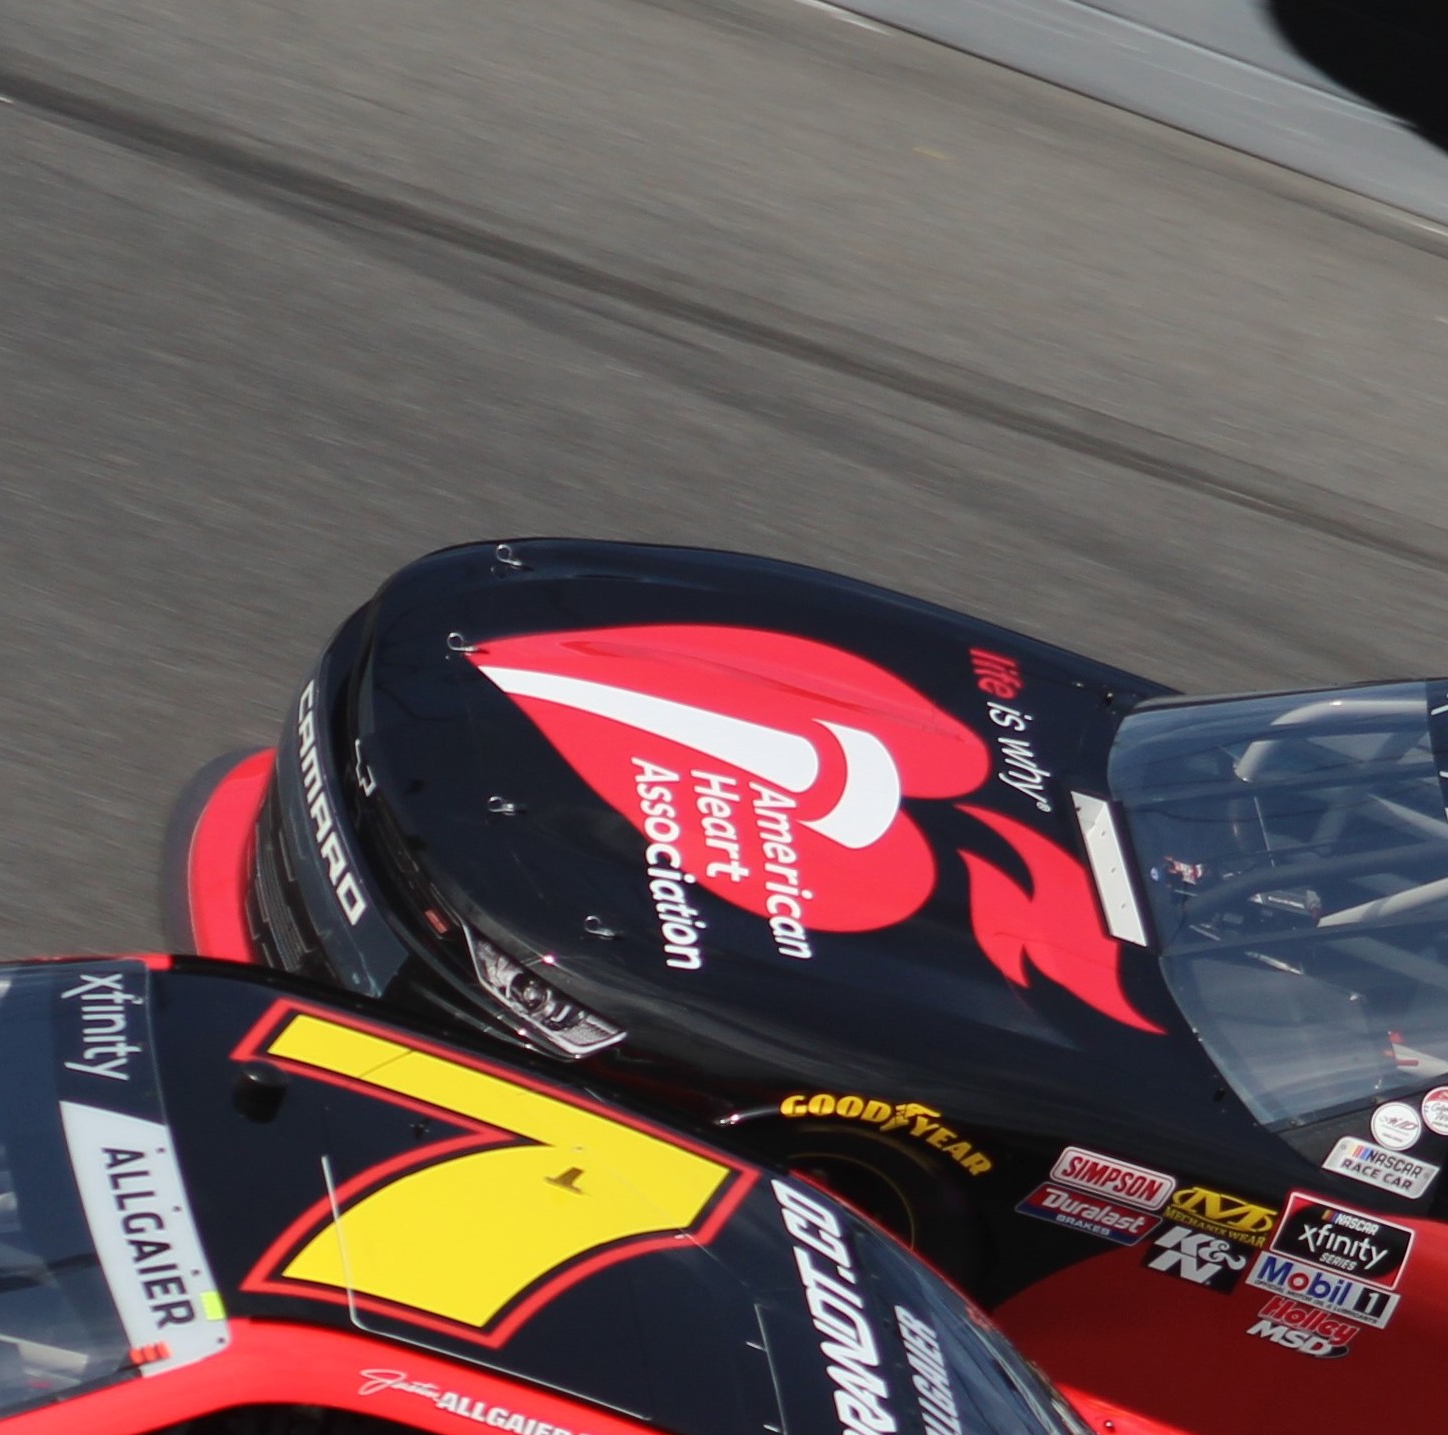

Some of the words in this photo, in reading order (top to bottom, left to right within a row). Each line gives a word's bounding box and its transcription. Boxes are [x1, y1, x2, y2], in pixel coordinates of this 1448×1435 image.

[970, 649, 1023, 699] life
[987, 701, 1033, 731] is
[998, 737, 1051, 803] why
[296, 679, 367, 927] CAMARO
[690, 769, 748, 883] Heart
[630, 757, 707, 971] Association
[750, 781, 814, 961] American
[780, 1094, 992, 1176] GOODYEAR
[243, 1005, 748, 1340] 7
[1061, 1156, 1164, 1202] SIMPSON
[1341, 1158, 1381, 1179] RACE
[1382, 1173, 1413, 1192] CAR
[1367, 1150, 1423, 1179] NASCAR
[1040, 1188, 1146, 1234] Duralast
[1055, 1213, 1110, 1237] BRAKES
[1334, 1213, 1380, 1236] NASCAR
[101, 1146, 196, 1330] ALLGAIER
[1298, 1223, 1389, 1270] xfinity
[1318, 1252, 1357, 1271] SERIES
[1258, 1256, 1352, 1306] Mobil
[1364, 1292, 1379, 1315] 1
[1246, 1319, 1334, 1356] MSD
[1258, 1295, 1361, 1348] Holley
